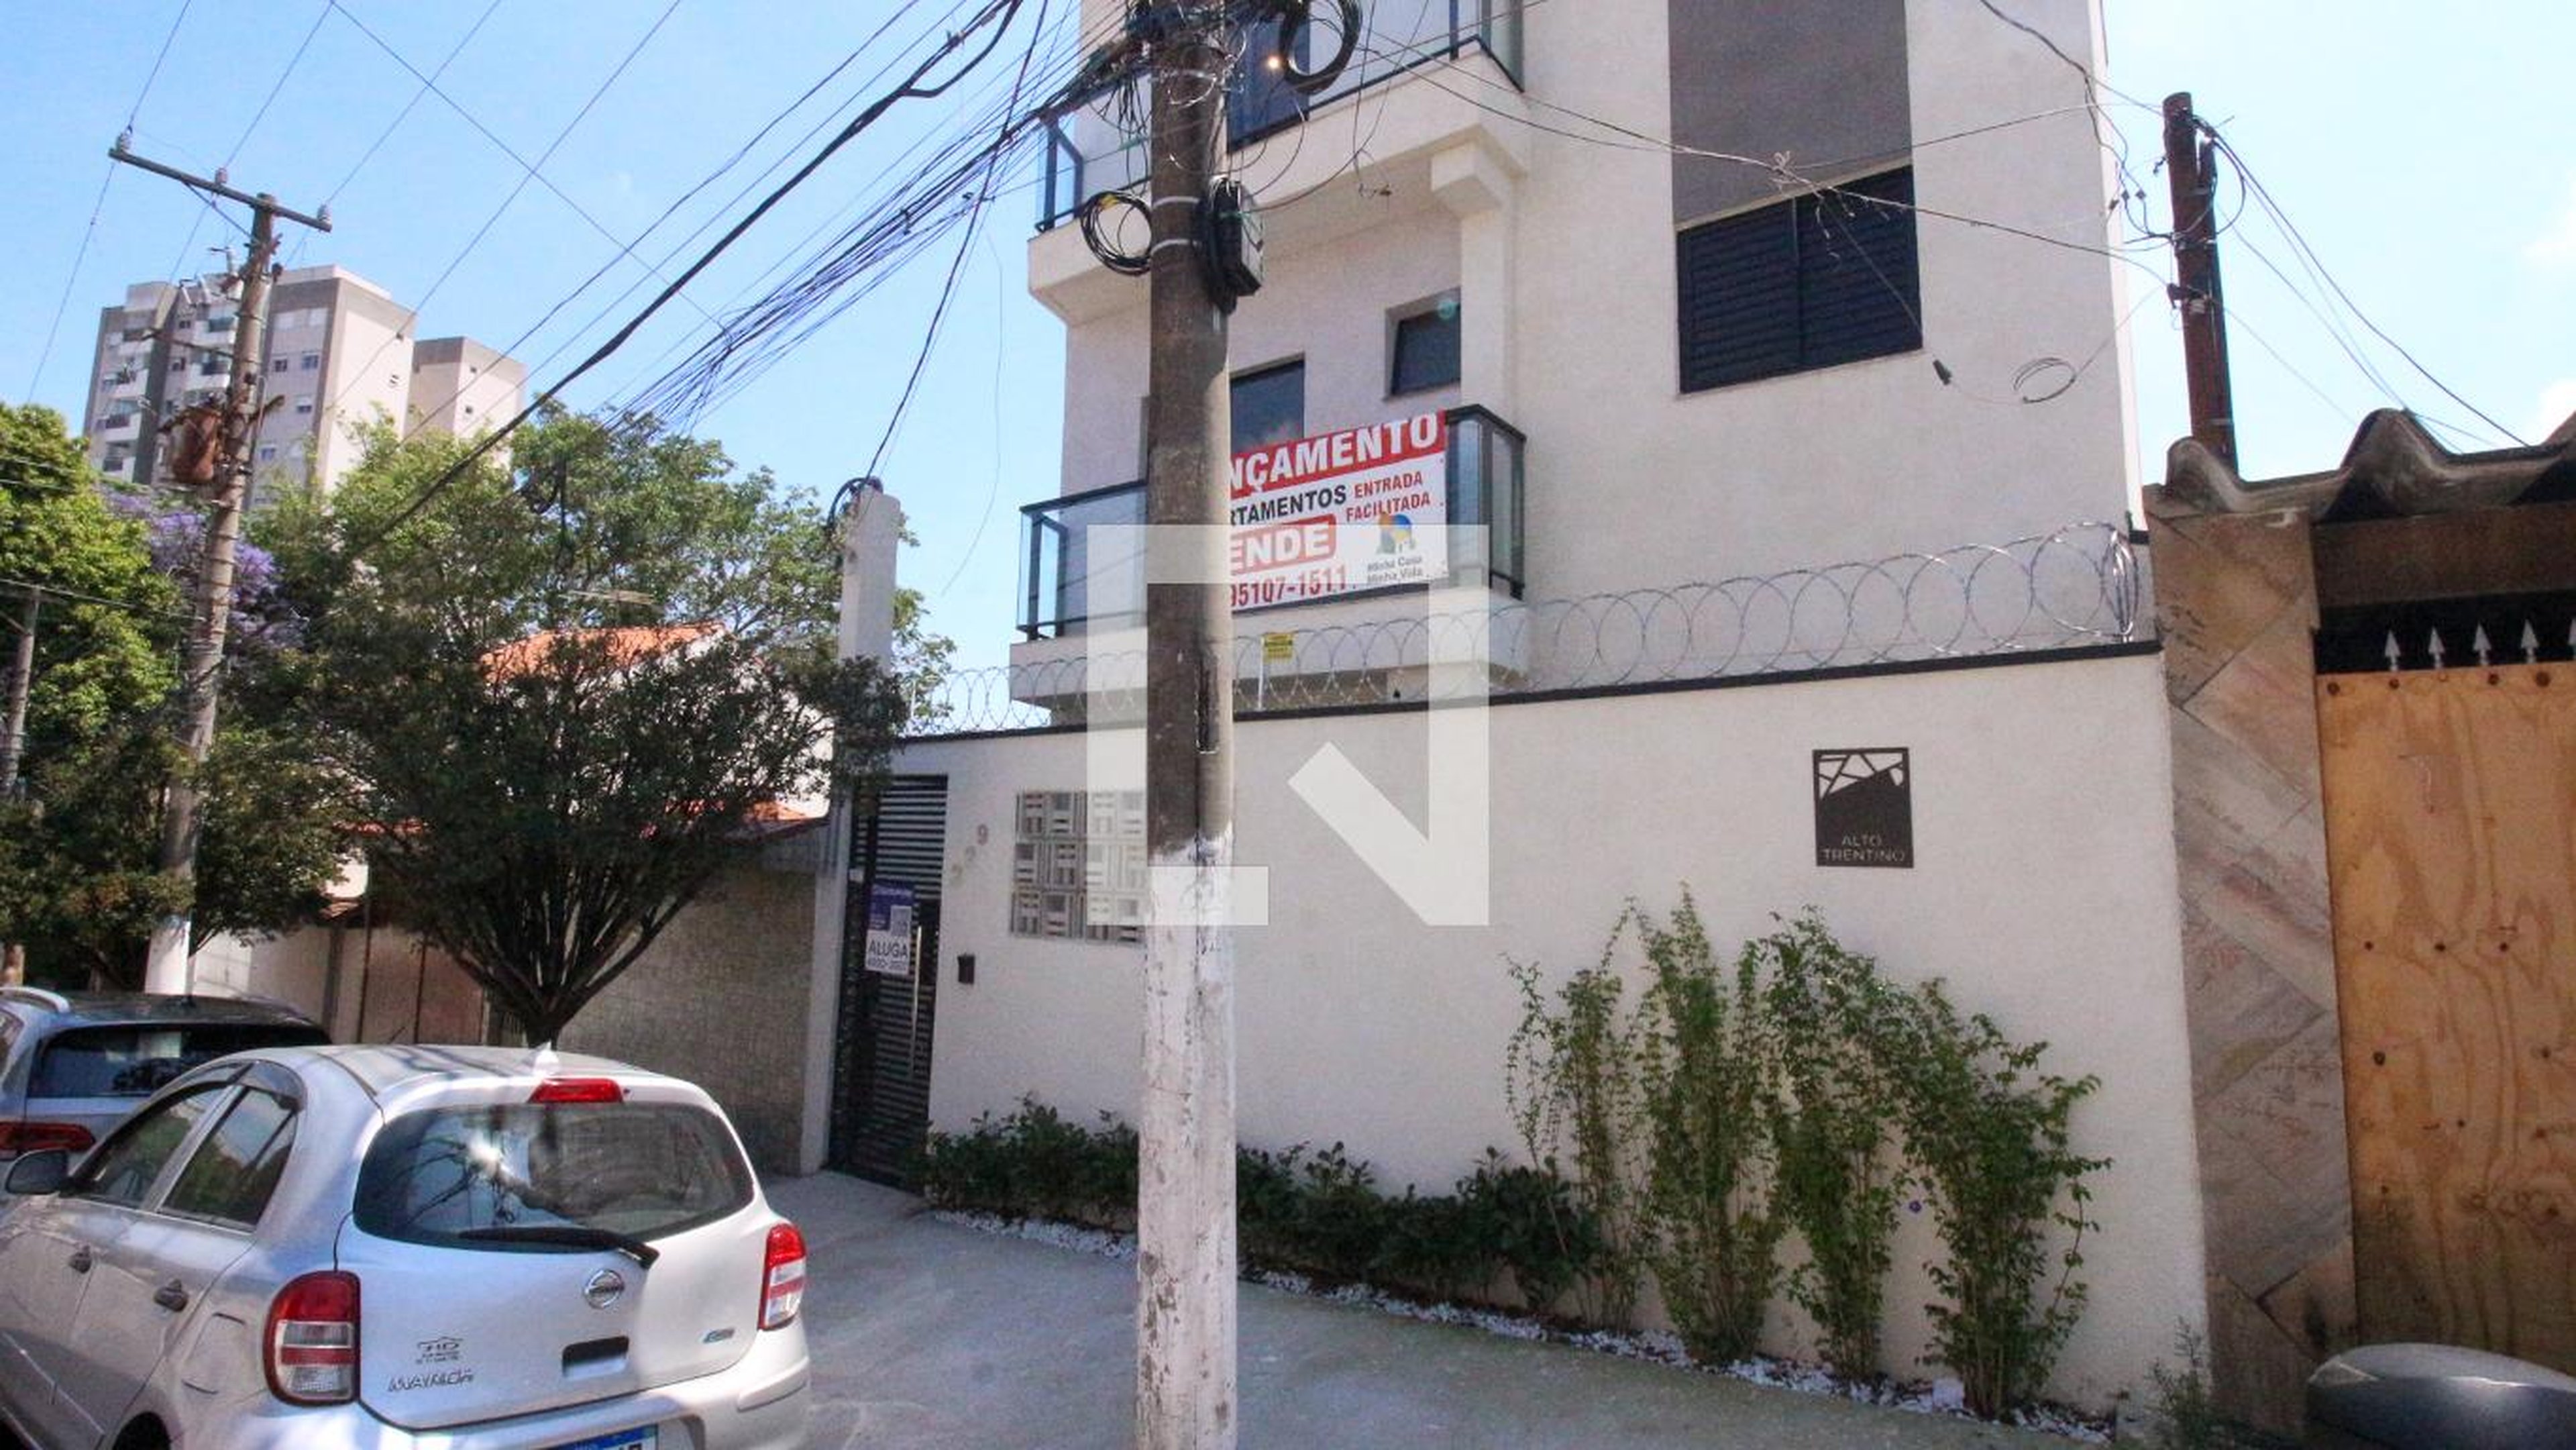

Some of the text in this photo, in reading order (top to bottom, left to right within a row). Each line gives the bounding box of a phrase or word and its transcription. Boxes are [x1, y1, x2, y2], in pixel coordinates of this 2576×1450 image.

[1230, 413, 1438, 493] NÇAMENTO
[1354, 471, 1423, 499] ENTRADA
[1230, 484, 1346, 525] RTAMENTOS
[1346, 492, 1431, 522] FACILITADA
[1230, 521, 1330, 570] ENDE
[1821, 849, 1905, 862] TRENTINO
[1842, 835, 1882, 847] ALTO
[869, 939, 908, 957] ALUGA
